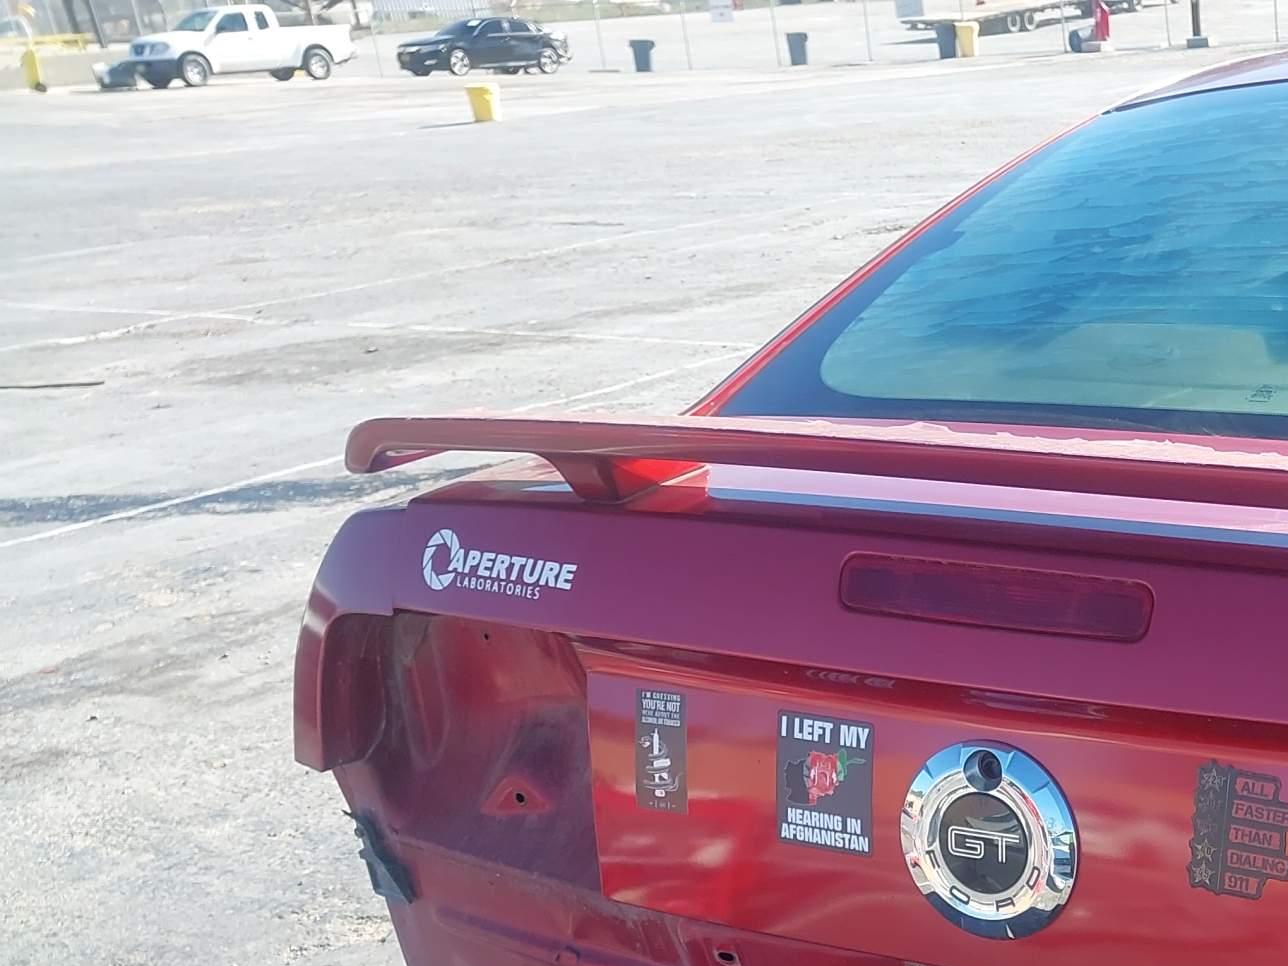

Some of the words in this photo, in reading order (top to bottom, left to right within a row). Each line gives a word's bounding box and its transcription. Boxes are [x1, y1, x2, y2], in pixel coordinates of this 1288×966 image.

[448, 548, 578, 590] APERTURE
[456, 576, 541, 600] LABORATORIES
[642, 698, 666, 711] YOU'RE
[666, 701, 681, 713] NOT
[780, 715, 788, 738] I
[793, 717, 834, 744] LEFT
[839, 725, 870, 749] MY
[1240, 780, 1270, 797] ALL
[786, 807, 843, 831] HEARING
[846, 818, 862, 835] IN
[781, 822, 869, 853] AFGHANISTAN
[948, 825, 1020, 864] GT
[1231, 827, 1273, 846] THAN
[1229, 851, 1286, 874] DIALING
[925, 849, 1042, 912] FORD
[1227, 874, 1250, 891] 911
